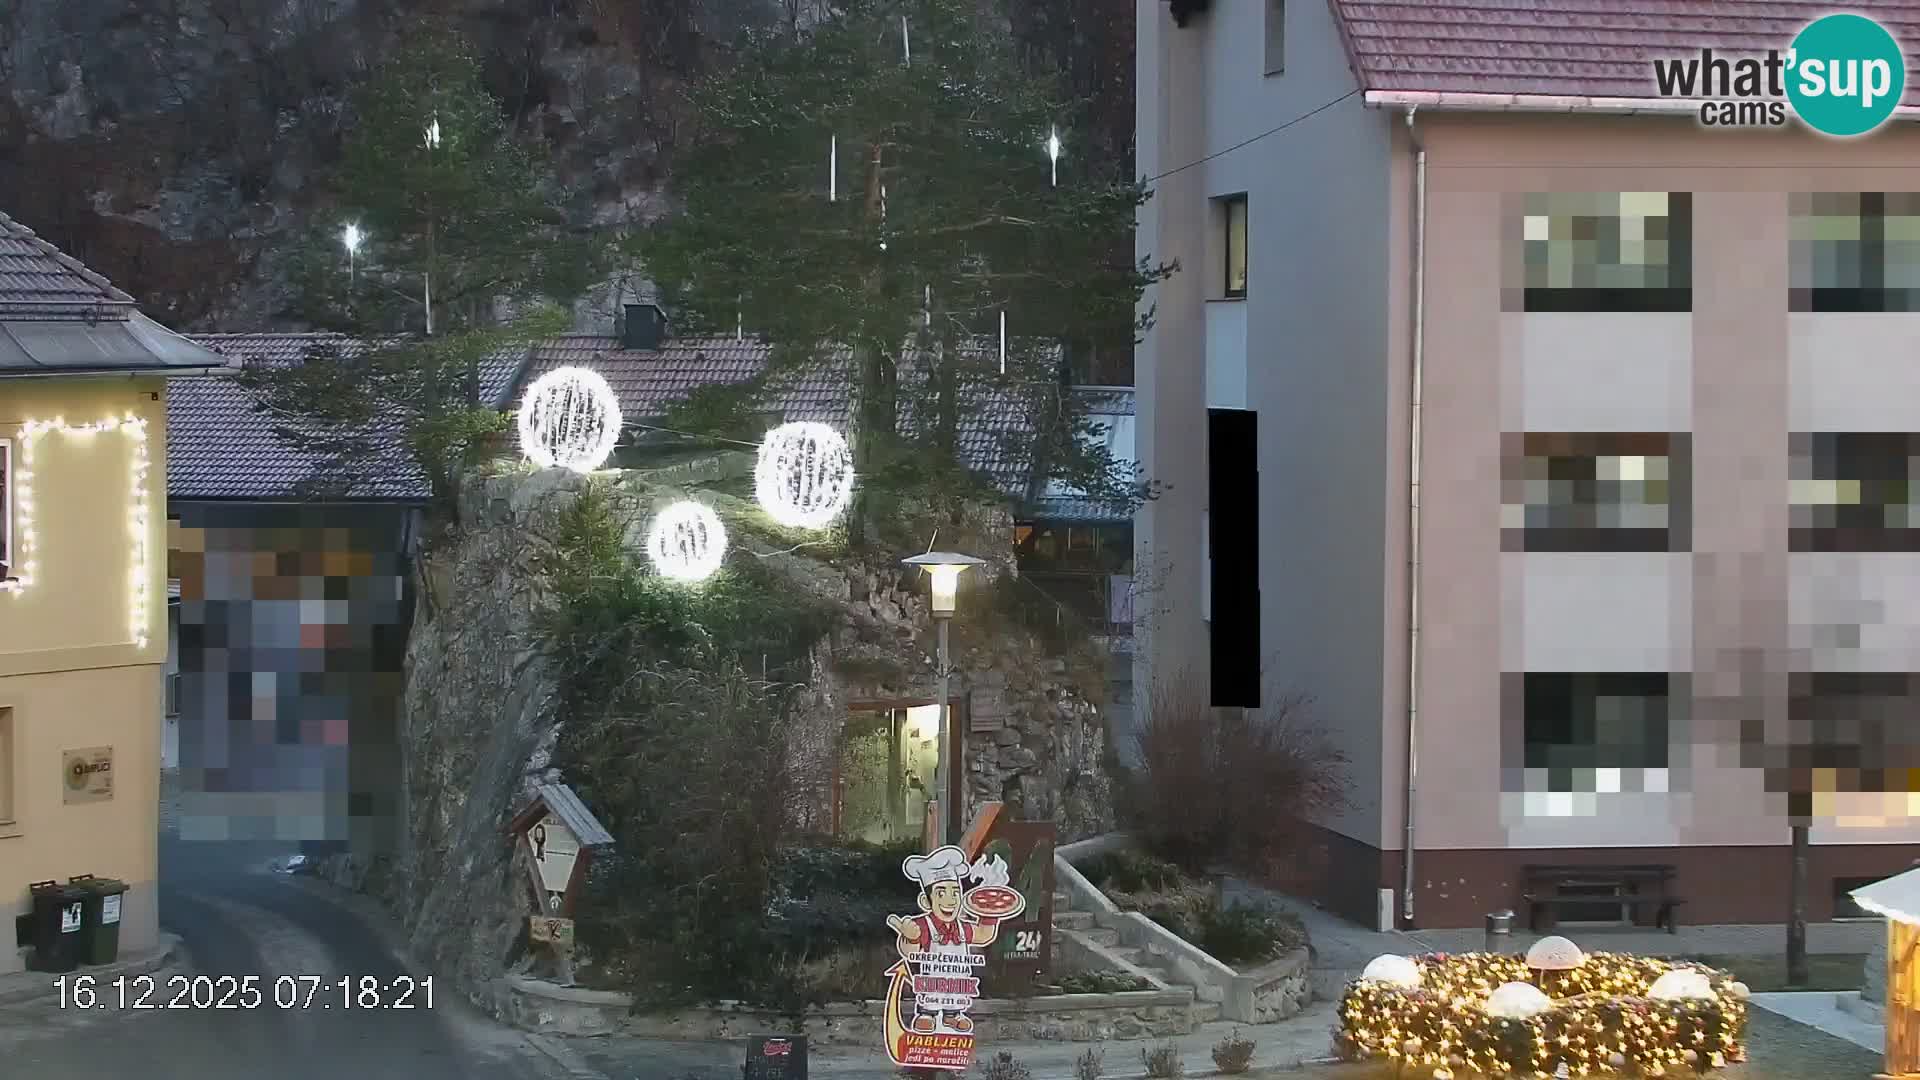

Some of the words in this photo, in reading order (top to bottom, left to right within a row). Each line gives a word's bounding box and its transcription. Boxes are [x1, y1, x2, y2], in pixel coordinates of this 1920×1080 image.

[909, 952, 985, 965] OKREPČEVALNICA
[922, 963, 932, 972] IN
[933, 964, 970, 974] PICERIJA
[906, 1035, 973, 1048] VABLJENI
